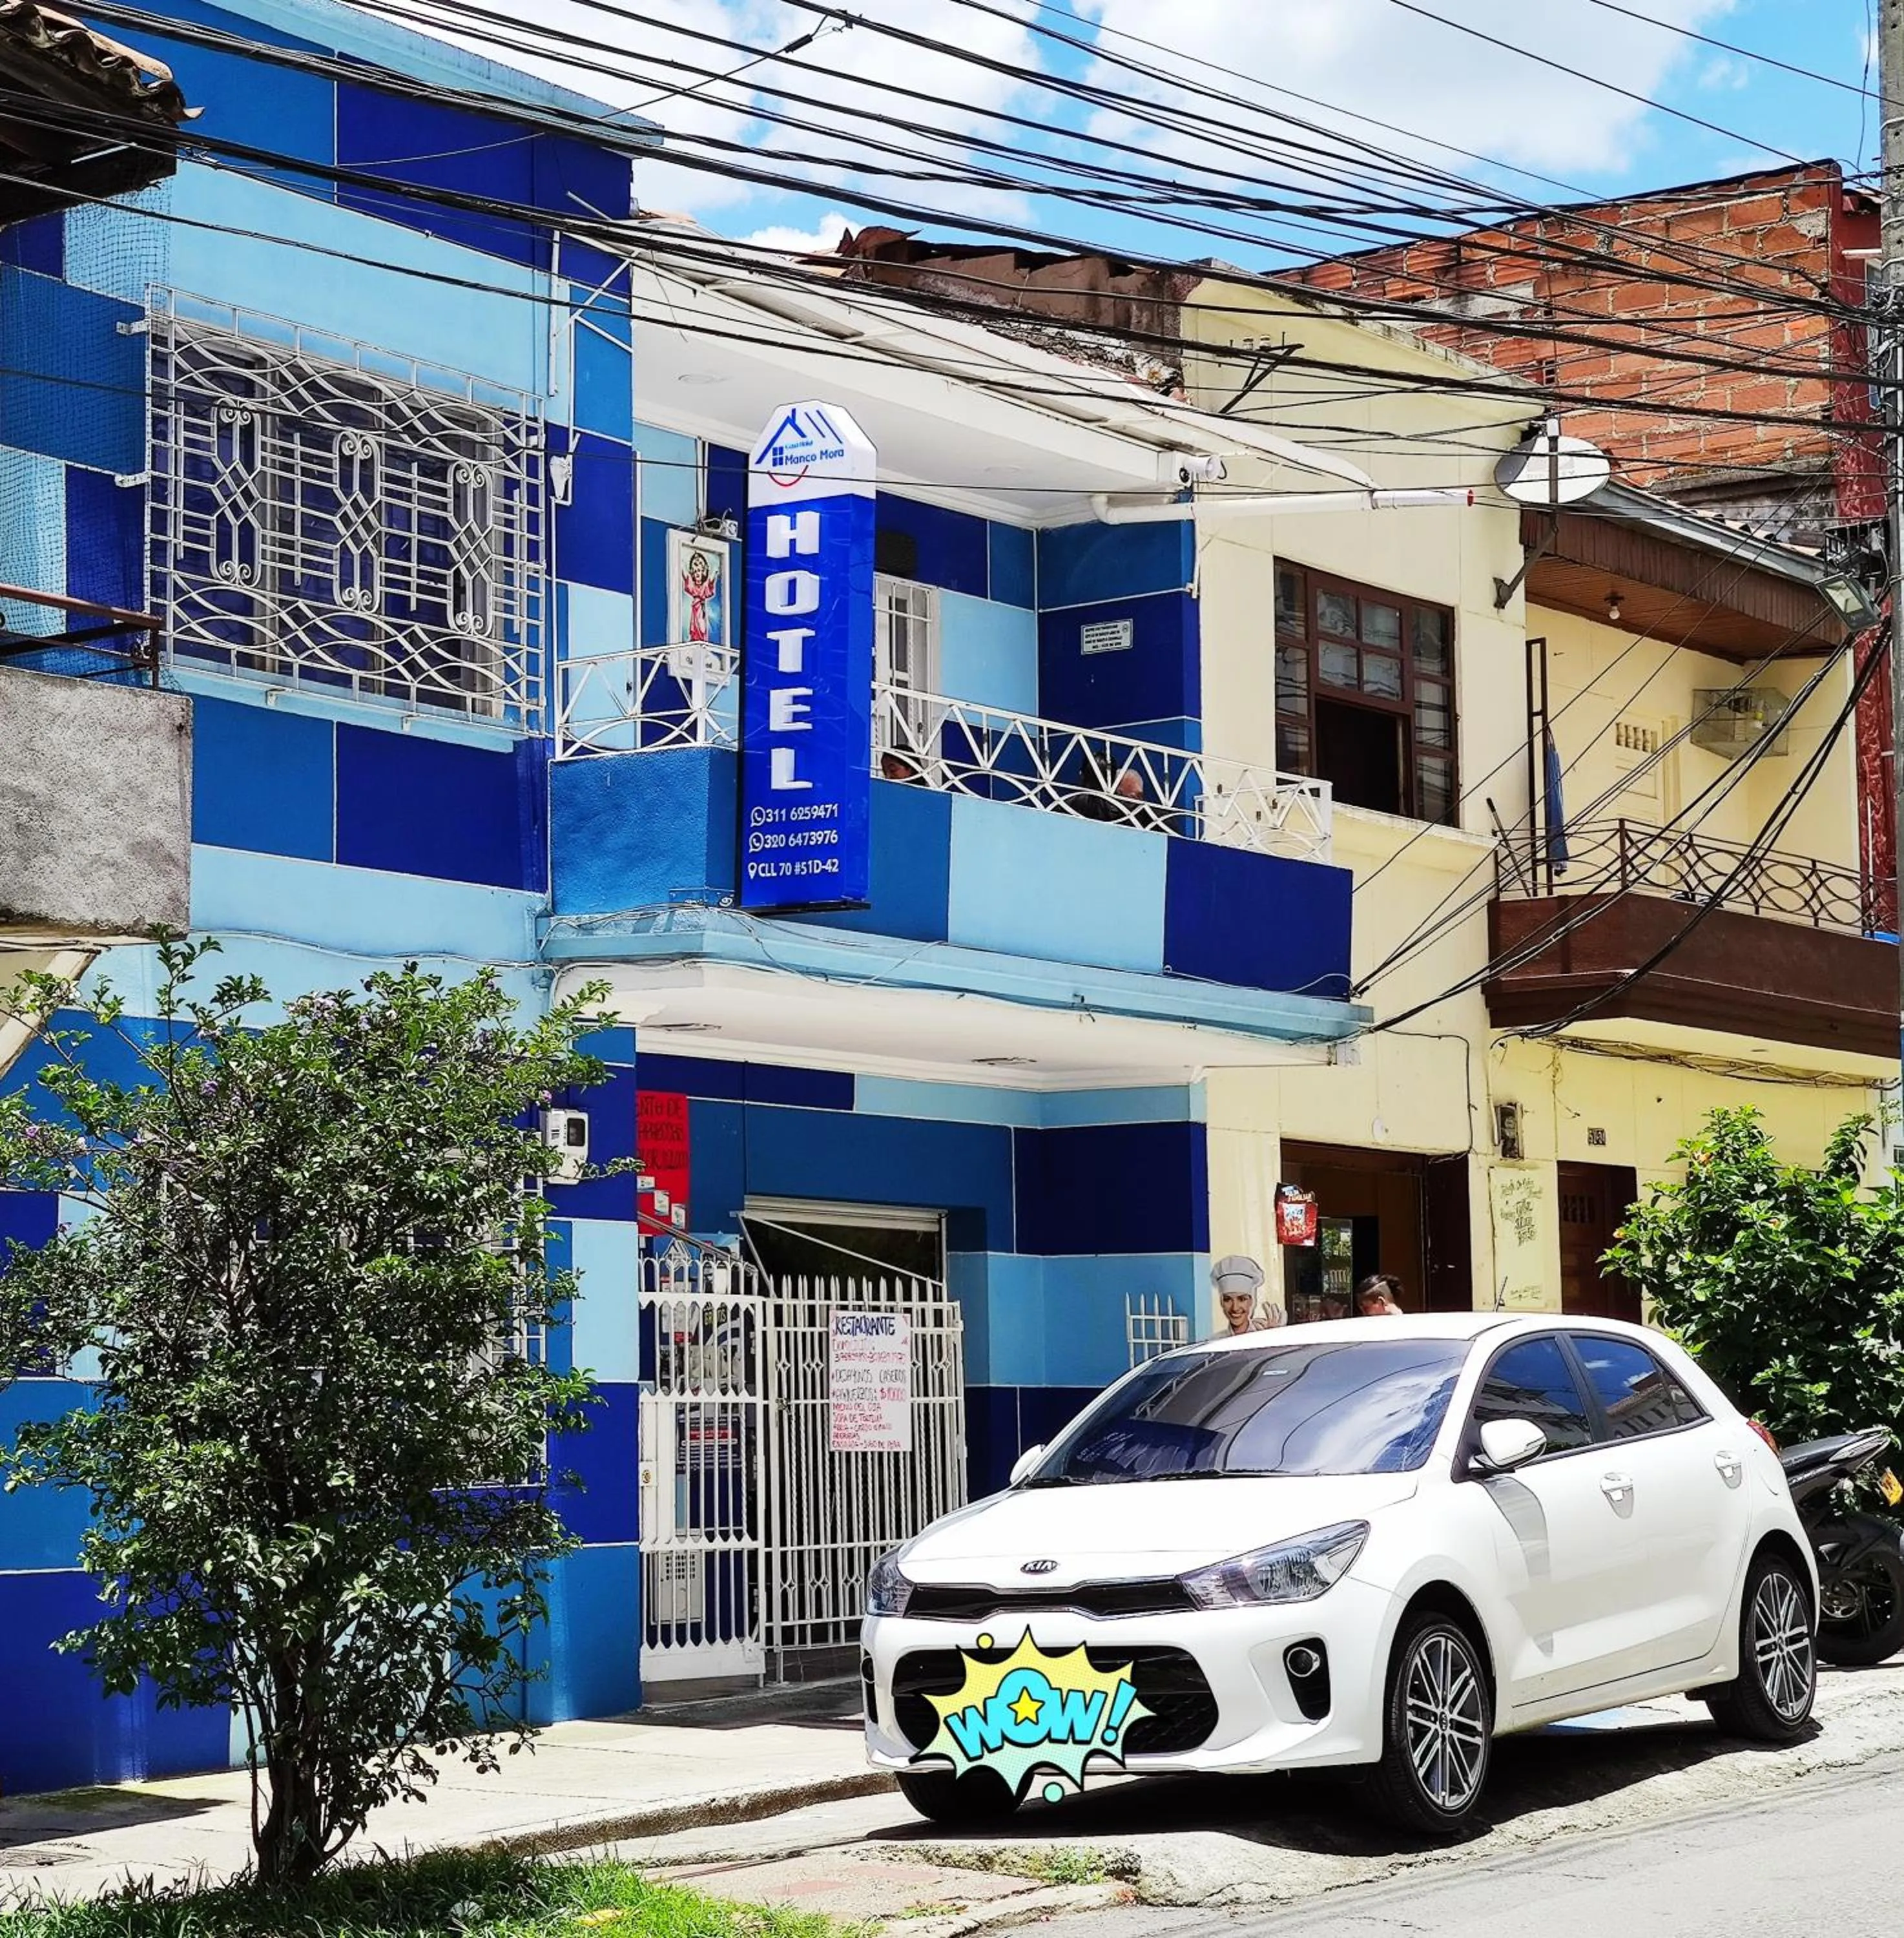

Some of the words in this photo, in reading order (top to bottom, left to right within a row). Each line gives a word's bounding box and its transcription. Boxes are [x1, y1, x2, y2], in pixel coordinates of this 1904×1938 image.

[785, 453, 817, 465] Manco
[820, 449, 844, 460] Mora
[765, 511, 820, 790] HOTEL
[766, 809, 786, 822] 311
[790, 804, 838, 820] 6259471
[765, 834, 785, 848] 320
[789, 829, 838, 847] 6473976
[758, 862, 777, 877] CLL
[779, 862, 792, 876] 70
[834, 1315, 896, 1337] RESTAURANTE
[1025, 1561, 1053, 1571] KIA
